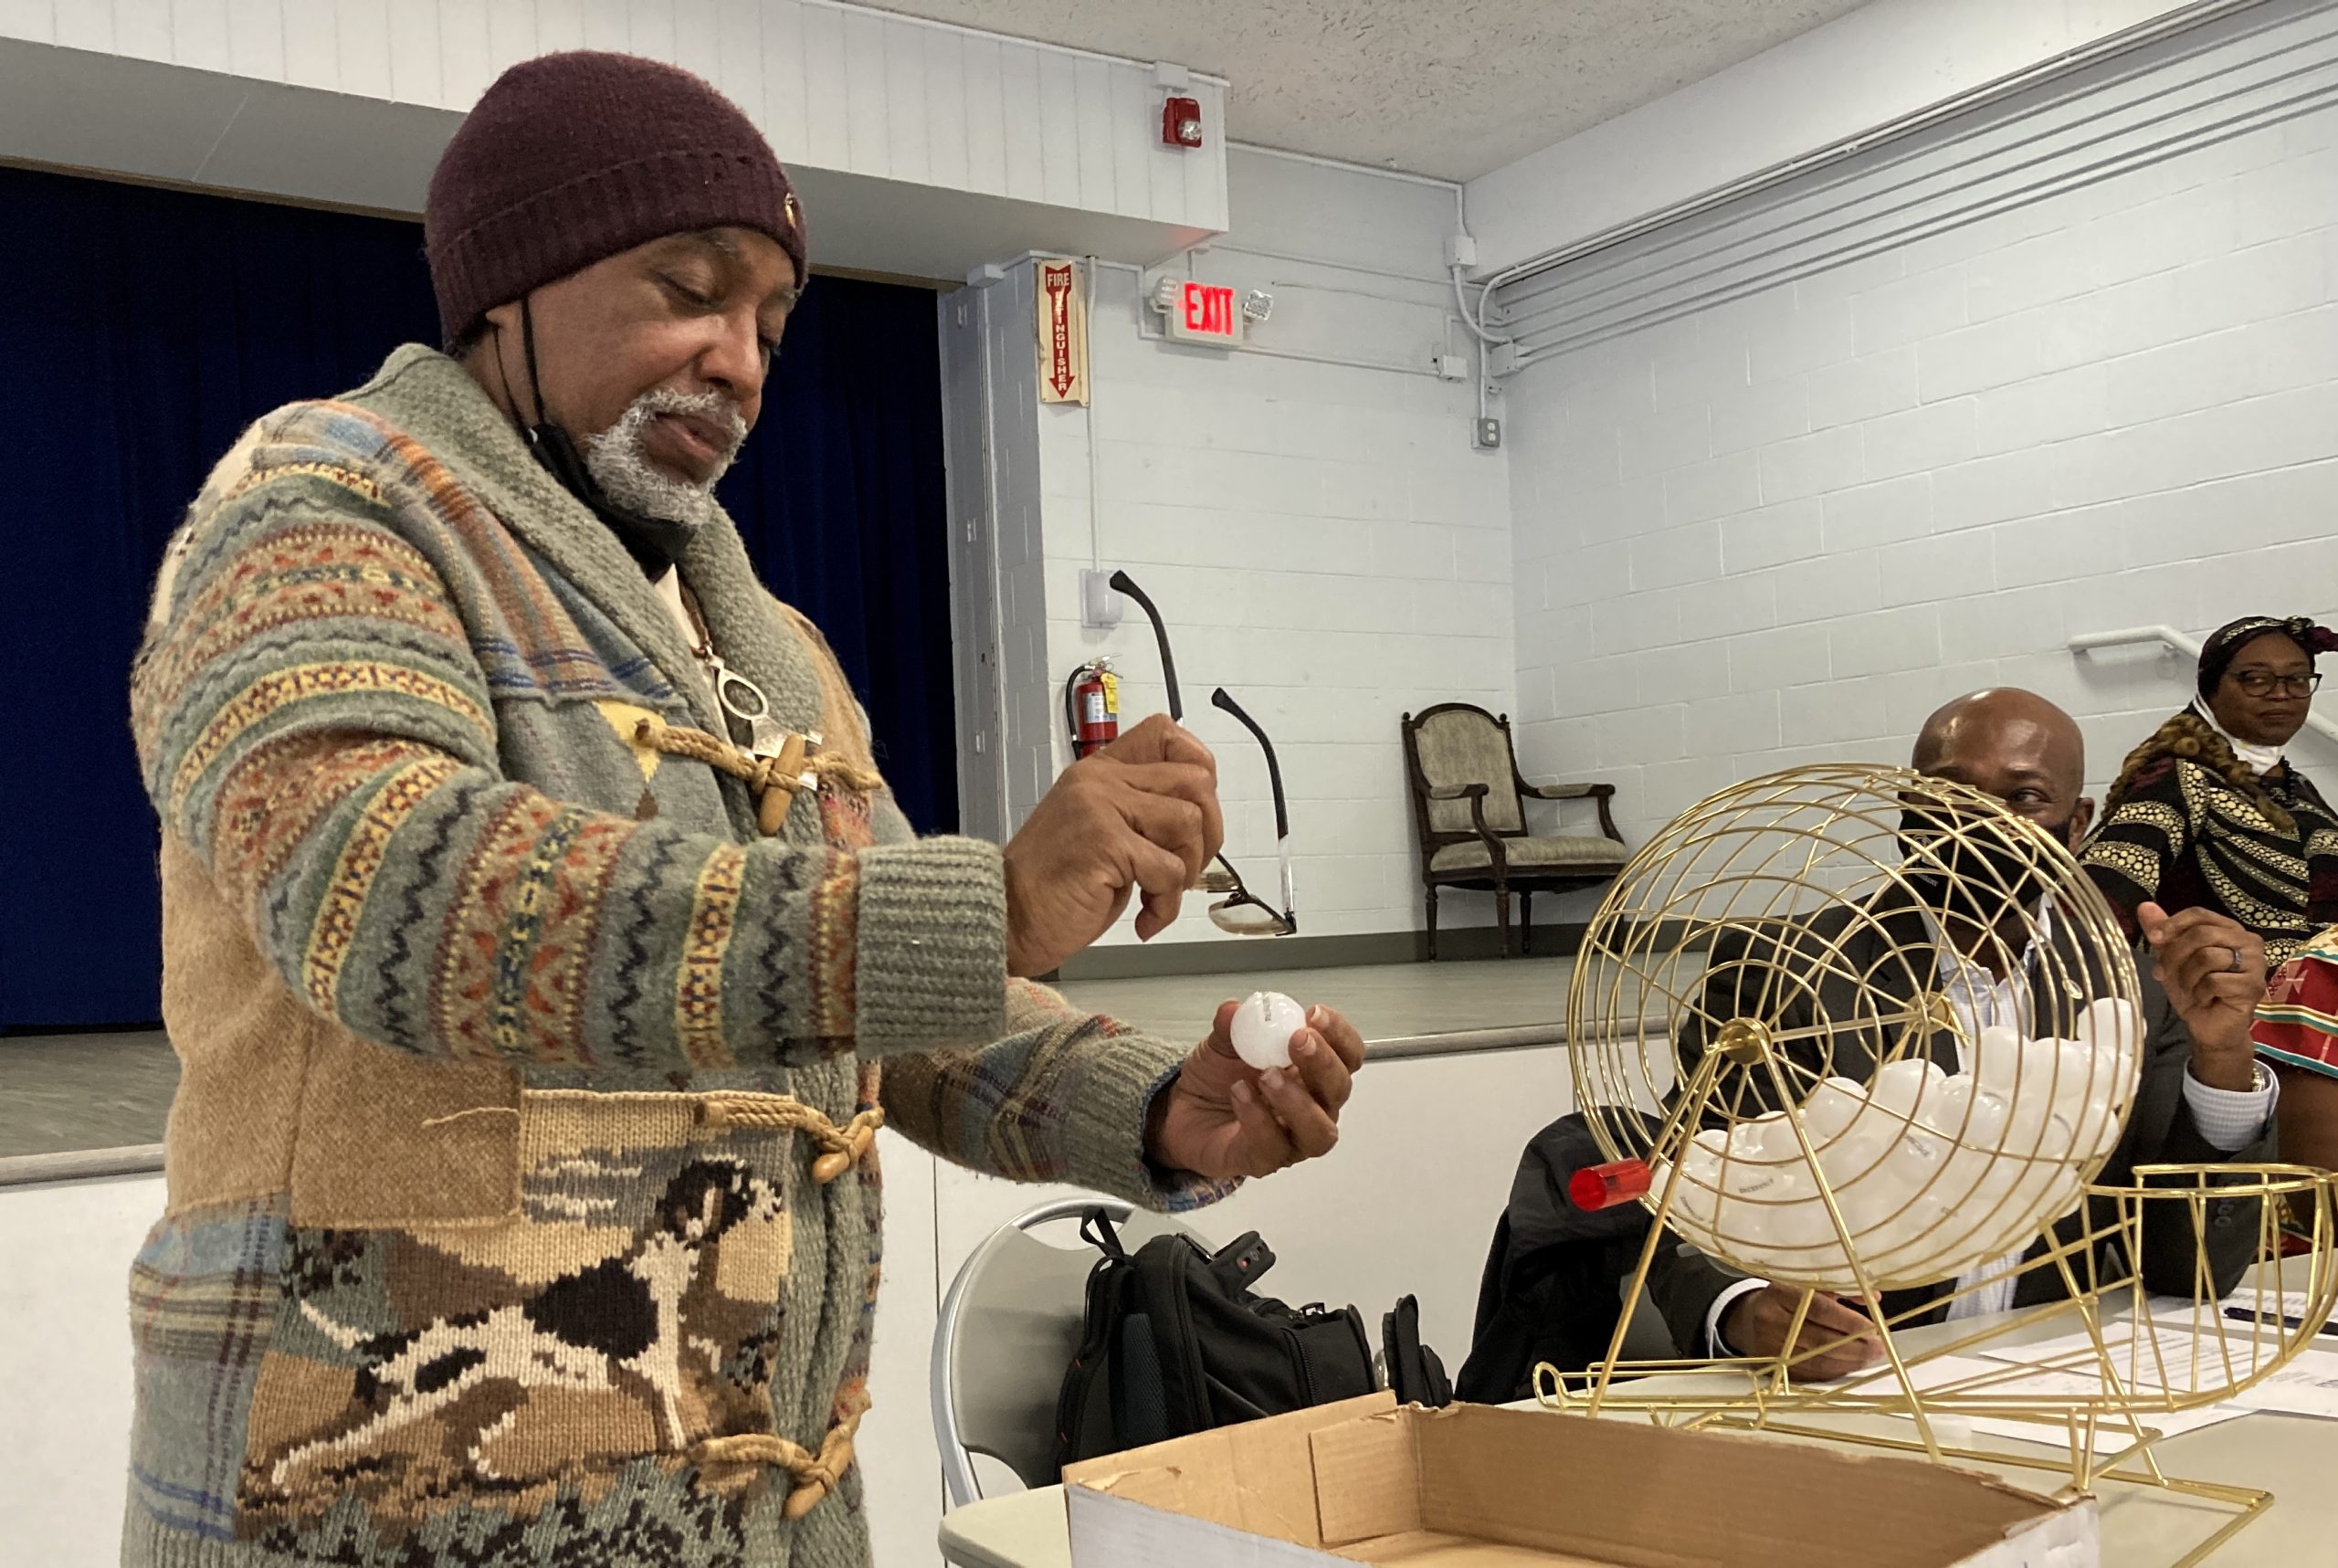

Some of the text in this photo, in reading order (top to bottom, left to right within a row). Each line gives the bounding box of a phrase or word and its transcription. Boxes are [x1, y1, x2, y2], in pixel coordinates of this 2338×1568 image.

[1047, 272, 1069, 287] FIRE
[1185, 282, 1233, 335] EXIT
[1055, 291, 1067, 391] EXTINGUISHER
